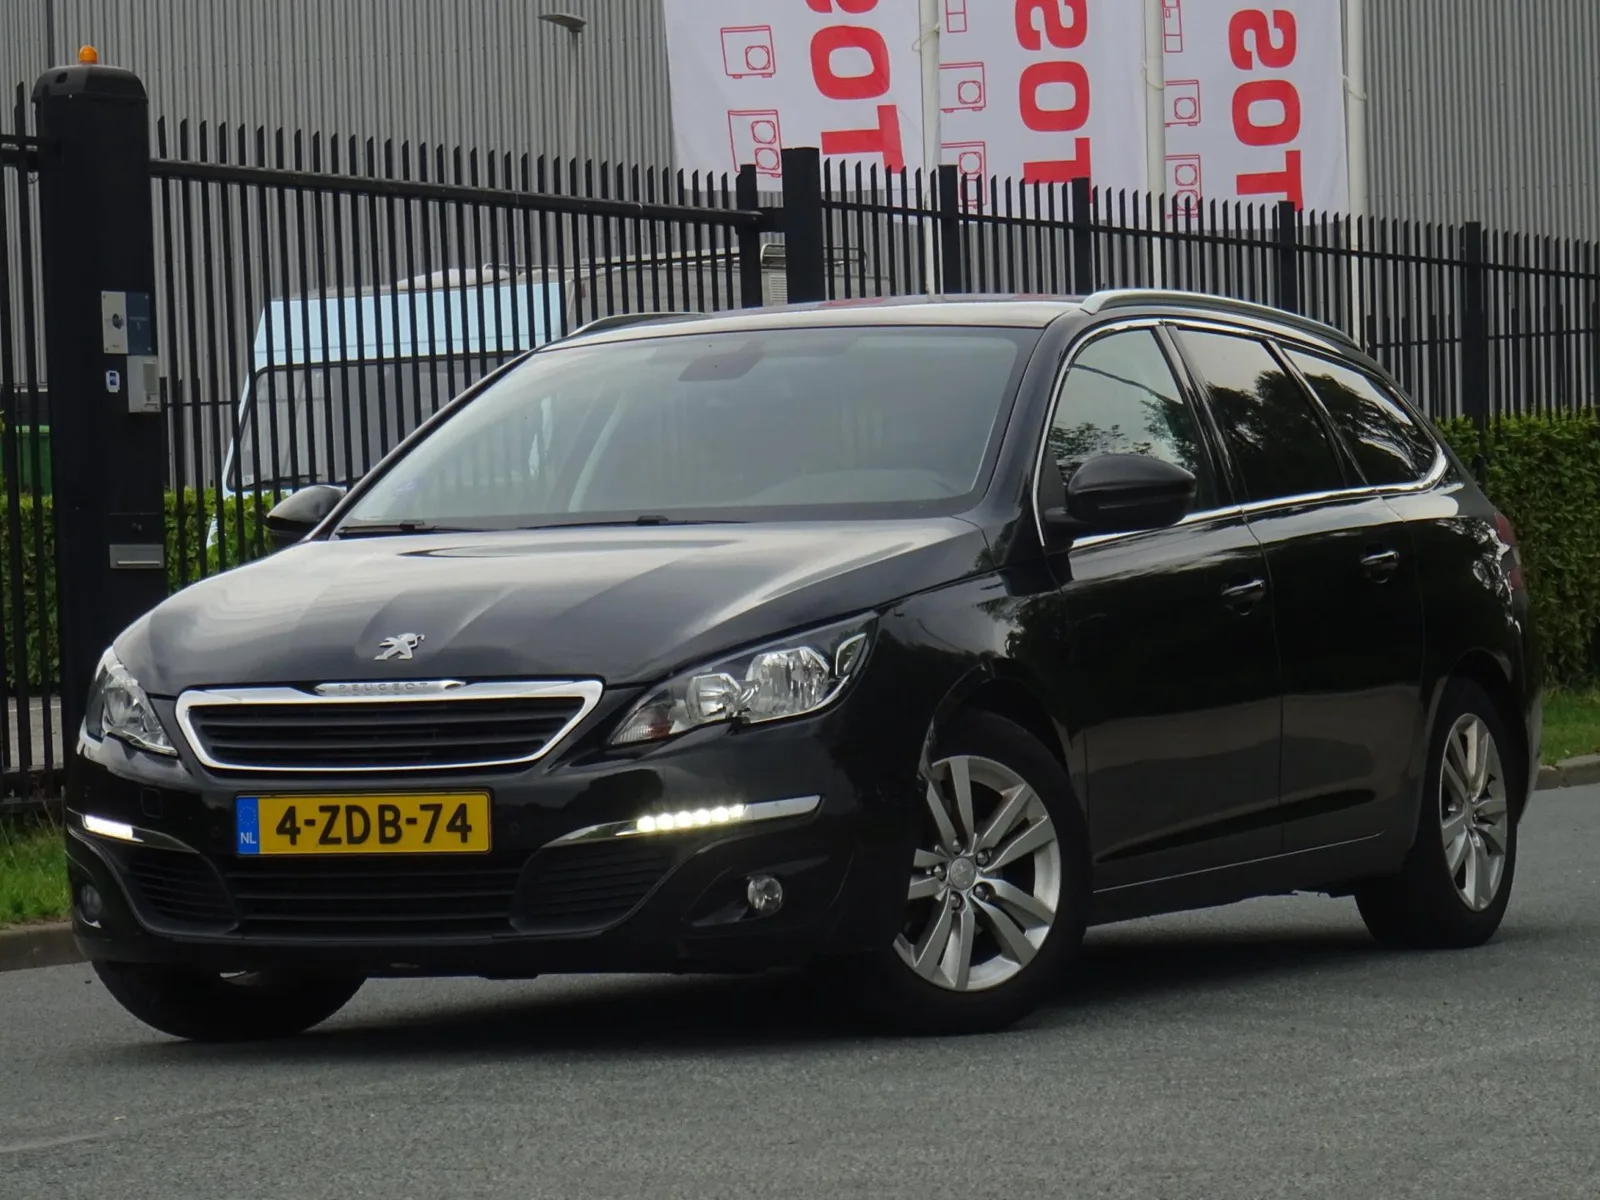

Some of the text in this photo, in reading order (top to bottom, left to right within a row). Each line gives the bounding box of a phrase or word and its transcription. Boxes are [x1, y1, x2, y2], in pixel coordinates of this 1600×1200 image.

[338, 682, 428, 692] PEUGEOT
[276, 802, 472, 846] 4-ZDB-74
[240, 831, 257, 845] NL
